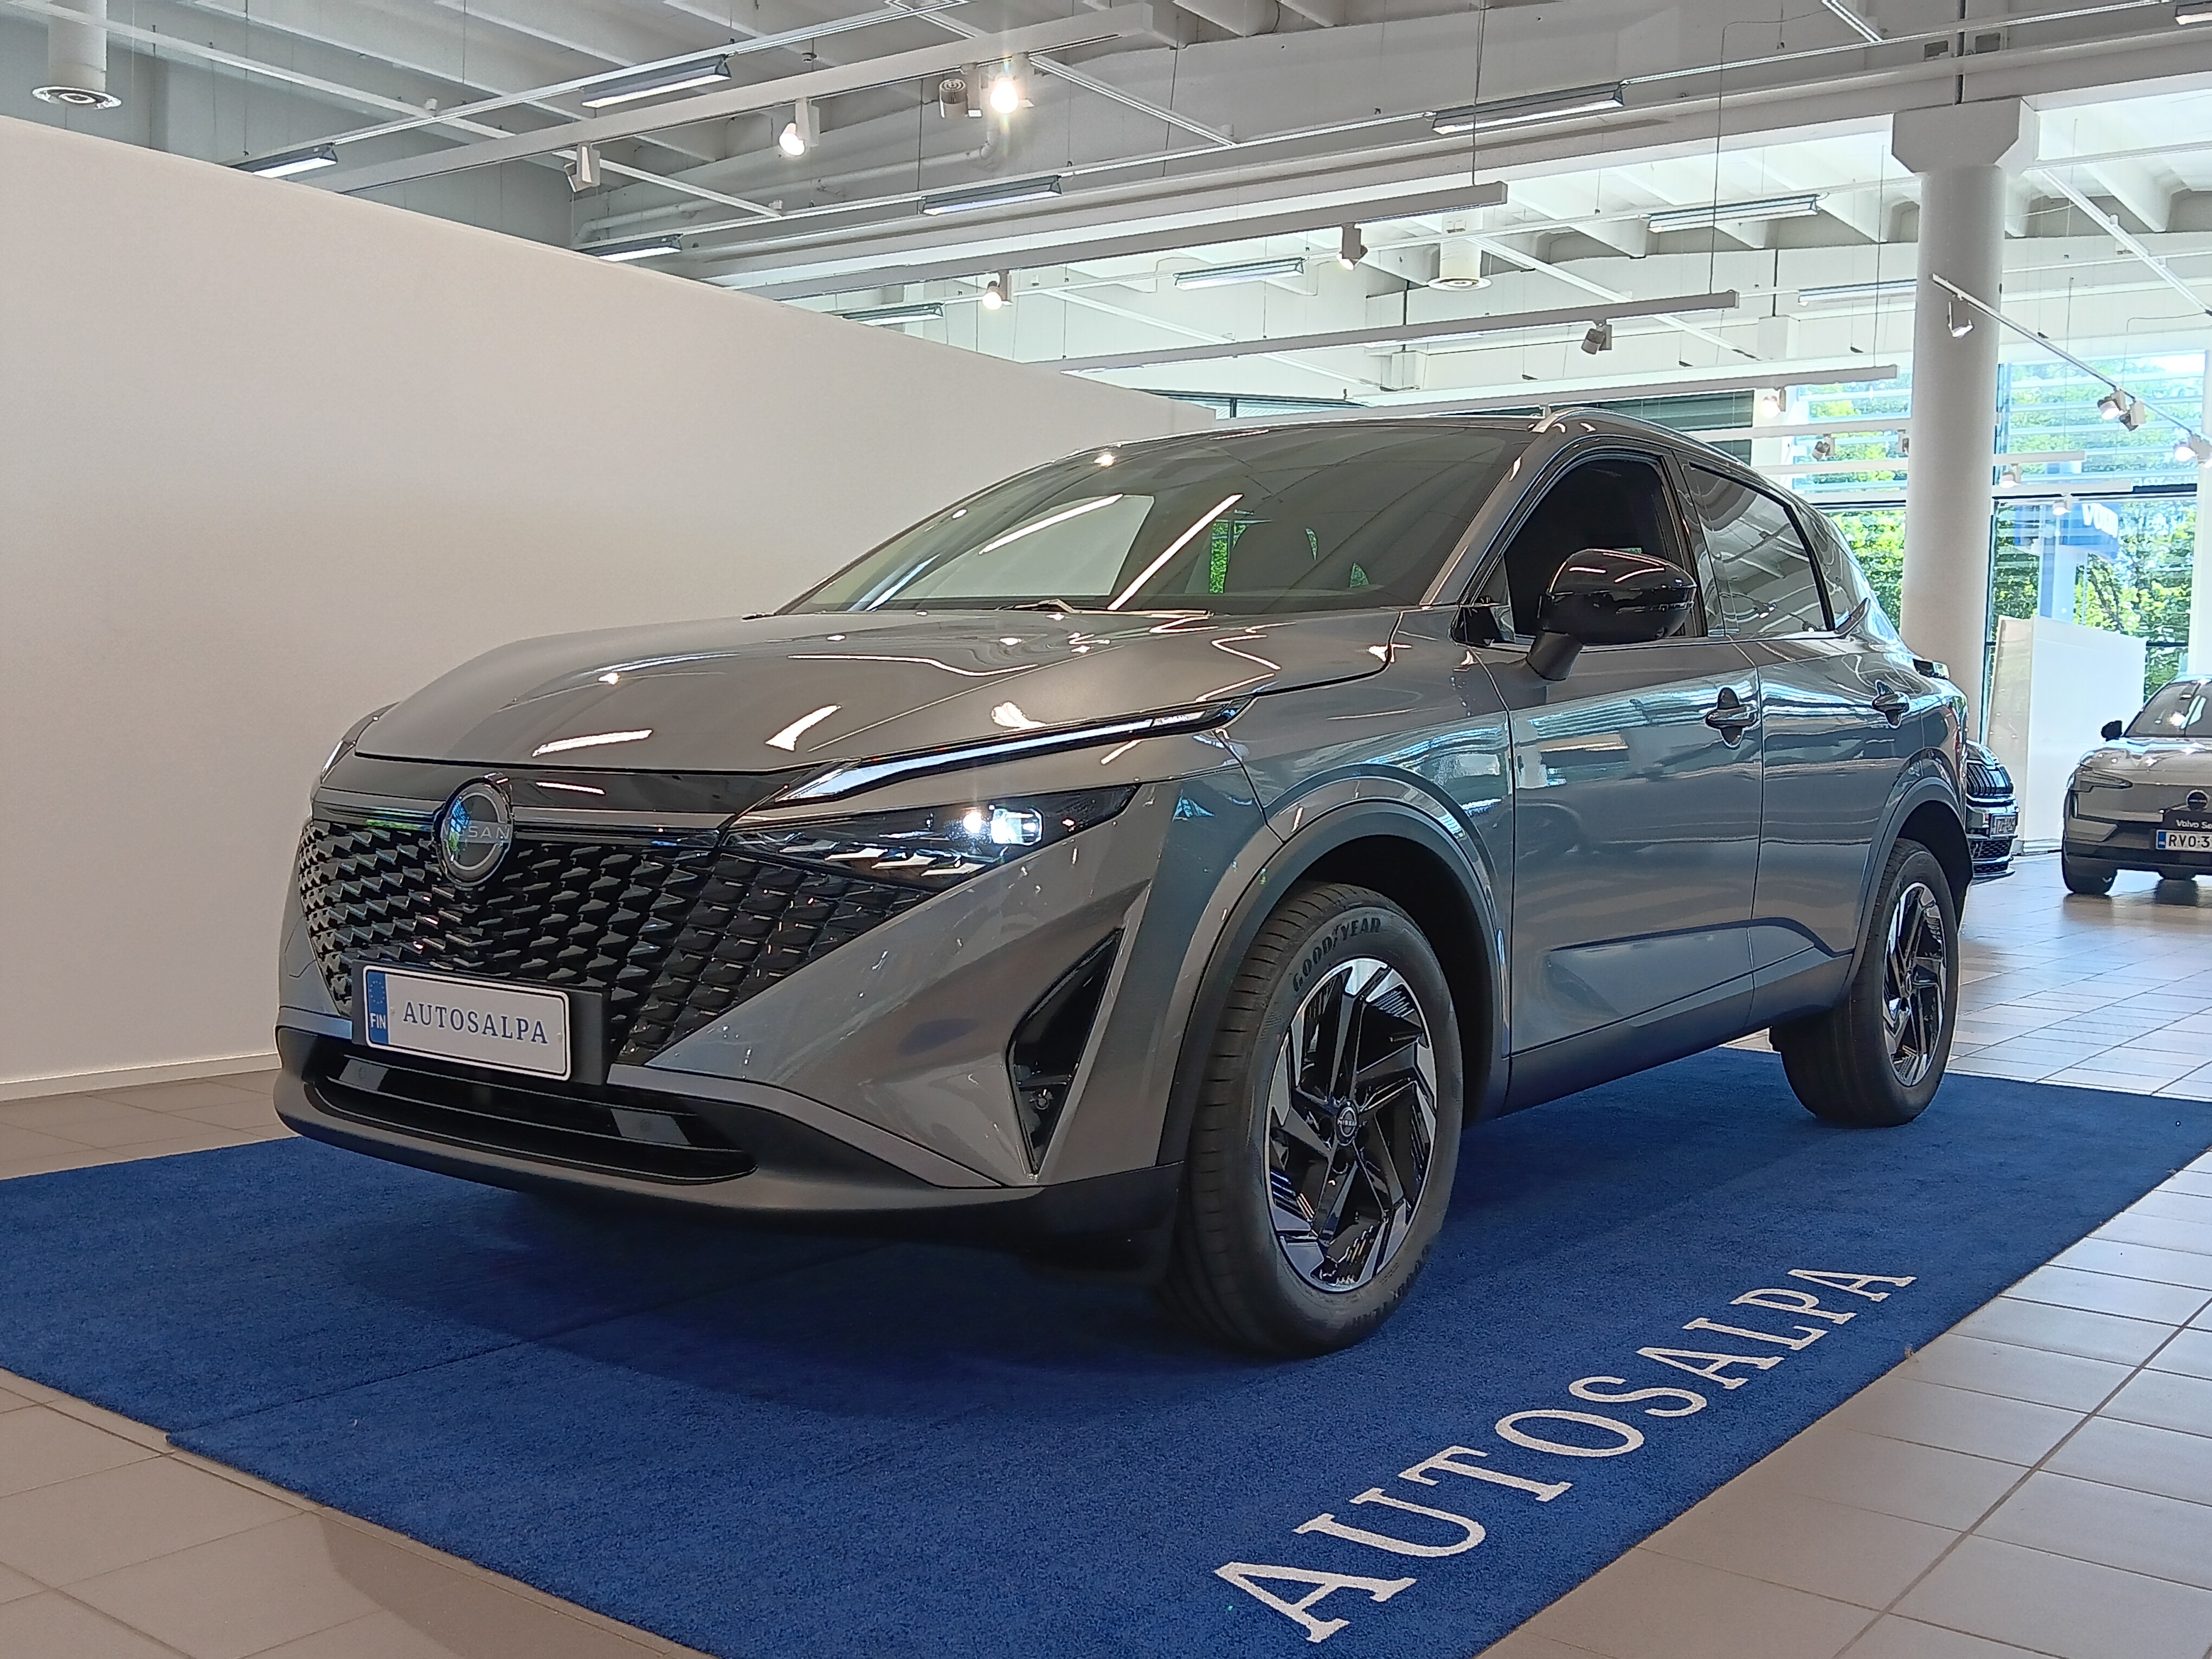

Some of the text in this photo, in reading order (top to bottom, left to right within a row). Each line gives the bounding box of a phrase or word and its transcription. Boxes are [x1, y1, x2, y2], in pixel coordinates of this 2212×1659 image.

[443, 824, 510, 839] NSAN
[2169, 835, 2212, 848] RVO-3
[1293, 917, 1381, 992] GOODYEAR
[370, 1012, 387, 1030] FIN
[403, 1002, 548, 1044] AUTOSALPA
[1214, 1269, 1917, 1643] AUTOSALPA
